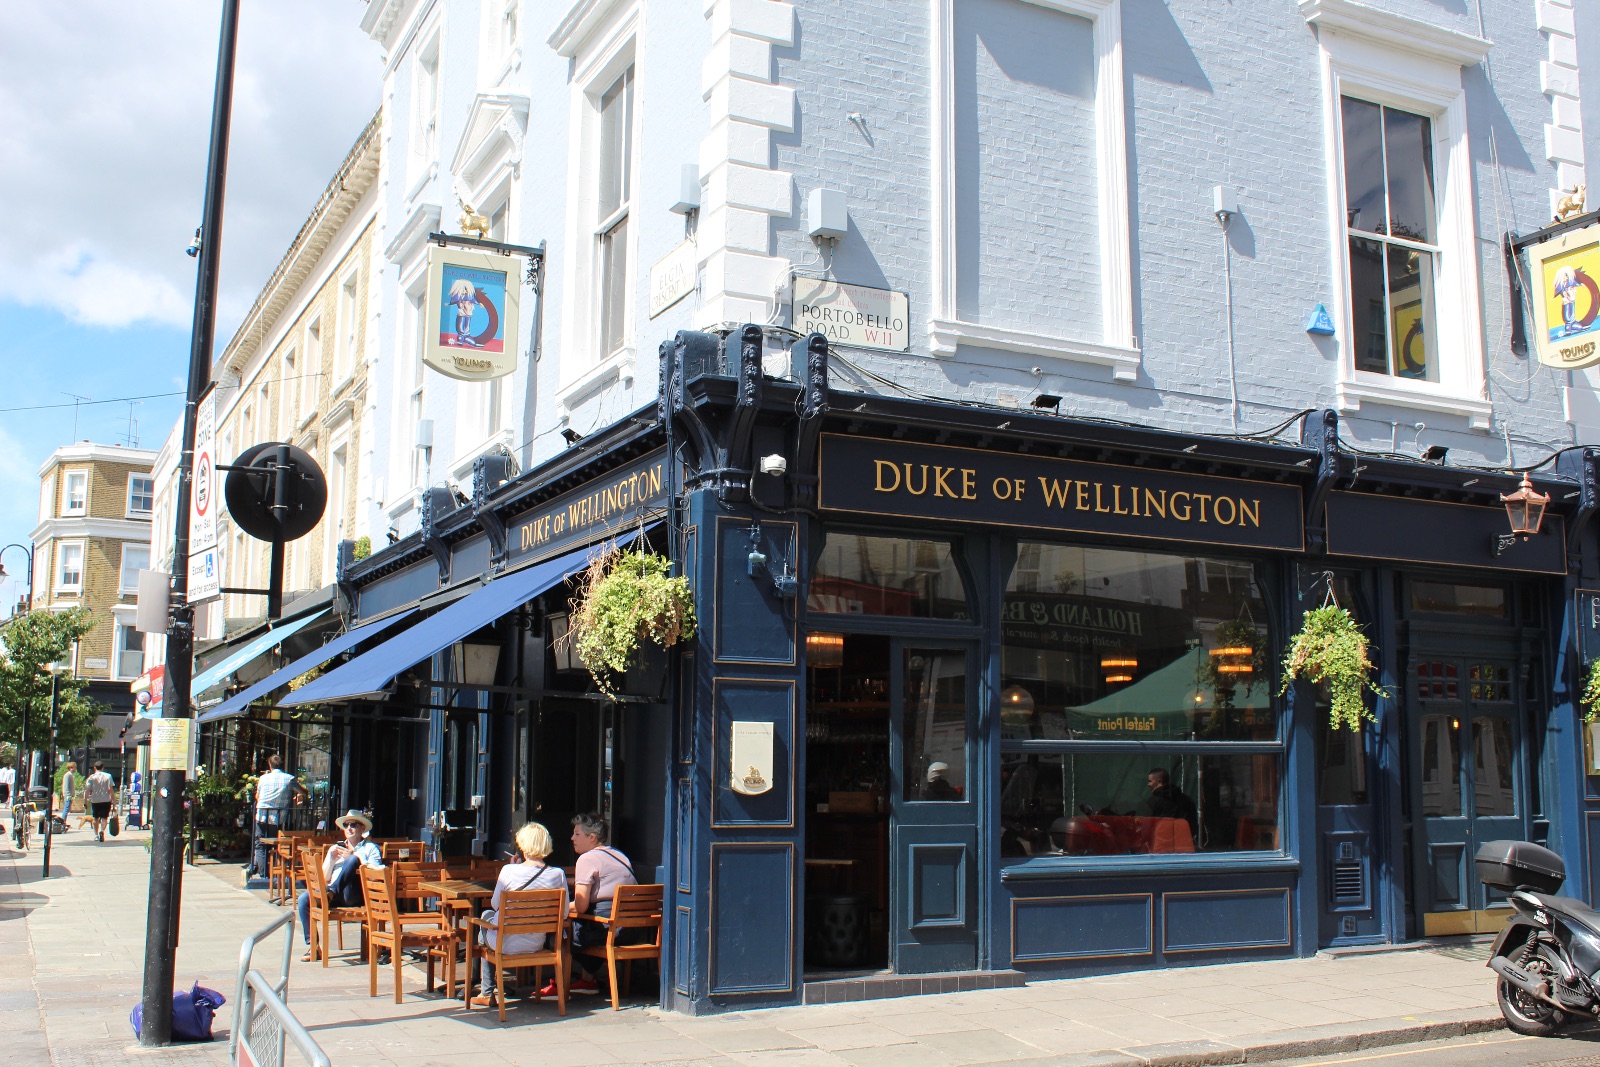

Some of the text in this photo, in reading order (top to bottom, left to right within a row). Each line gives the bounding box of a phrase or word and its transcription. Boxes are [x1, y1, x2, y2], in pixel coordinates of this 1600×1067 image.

[660, 263, 683, 290] ELGIN
[802, 304, 903, 331] PORTOBELLO
[865, 329, 892, 346] W.11
[1559, 341, 1596, 359] YOUNG'S
[452, 355, 492, 368] YOUNG'S
[873, 459, 1261, 528] DUKE OF WELLINGTON
[521, 464, 662, 551] DUKE OF WELLINGTON
[192, 564, 206, 576] Except
[203, 582, 218, 593] access
